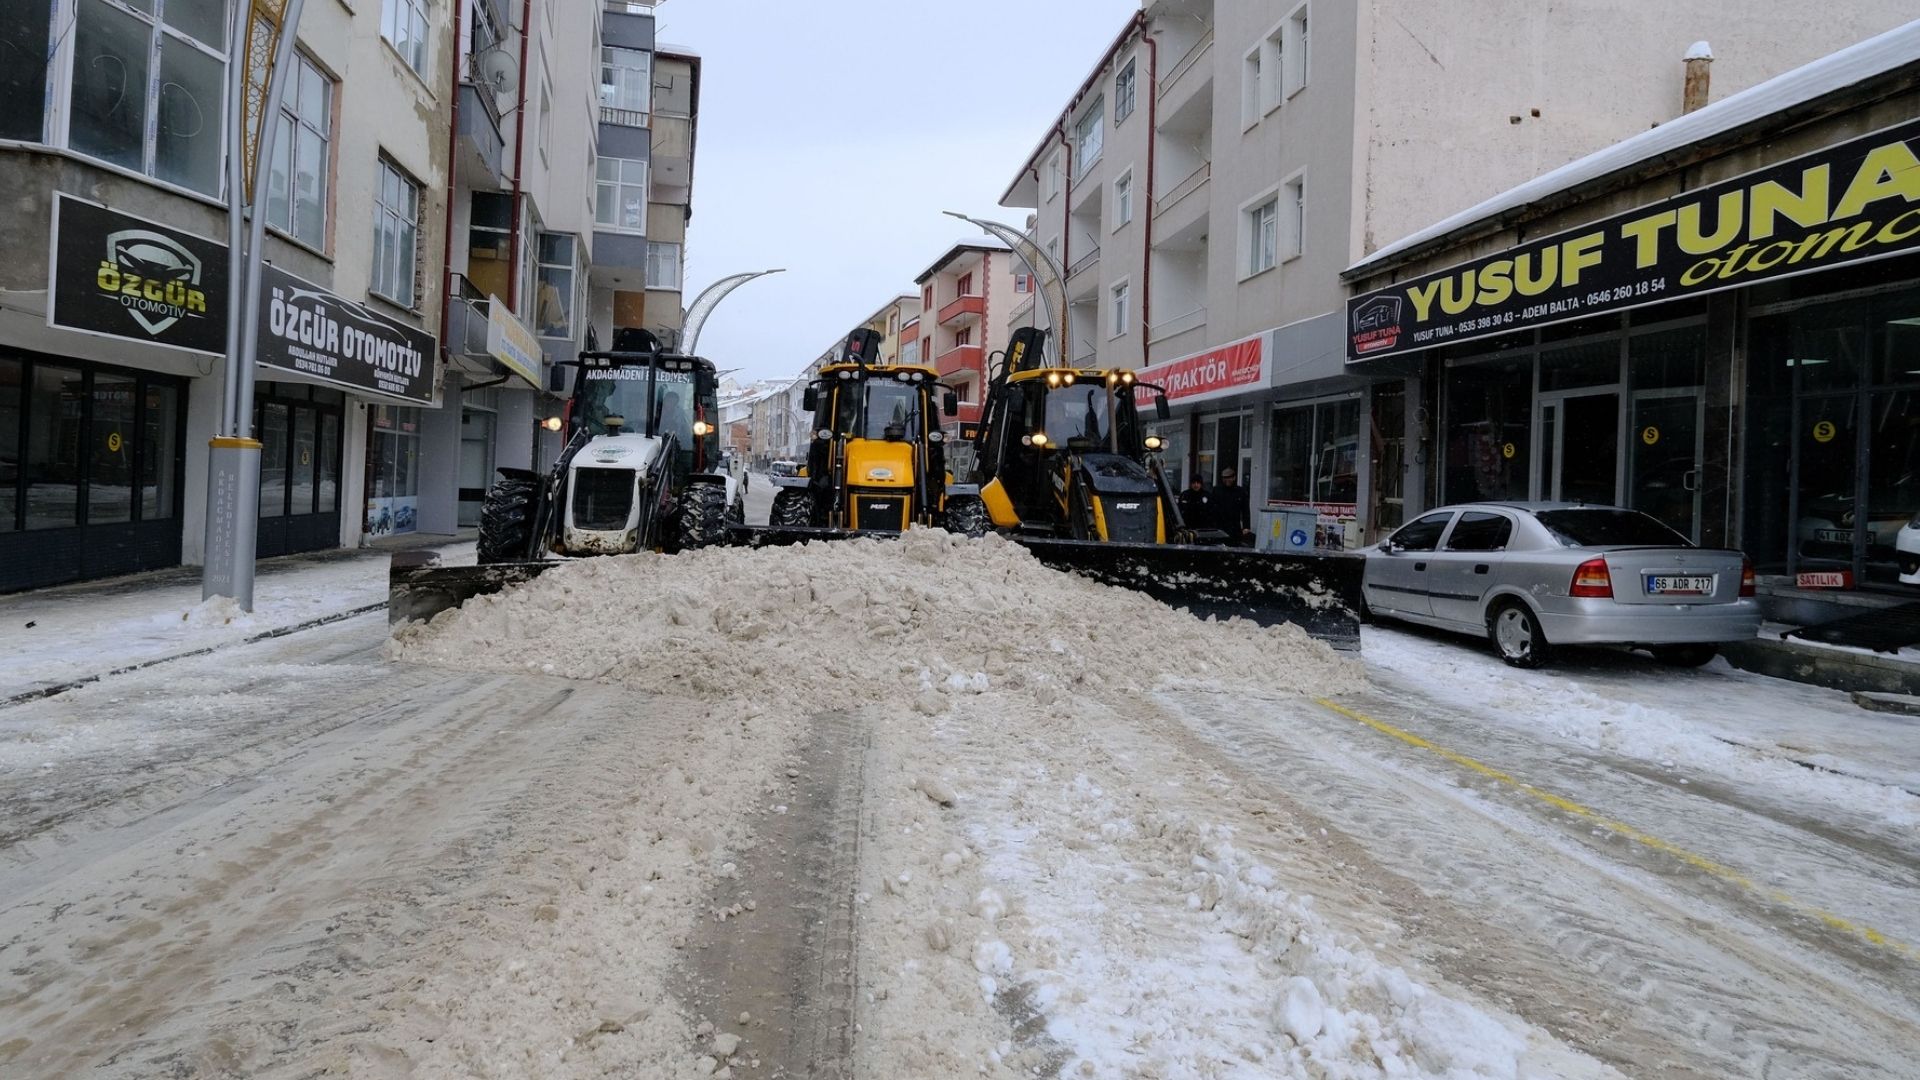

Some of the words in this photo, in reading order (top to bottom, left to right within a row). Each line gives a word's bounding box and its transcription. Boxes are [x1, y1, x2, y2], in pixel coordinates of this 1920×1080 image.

[1405, 230, 1605, 322] YUSUF
[1621, 140, 1920, 270] TUNA
[97, 260, 206, 313] ÖZGÜR
[120, 294, 186, 318] OTOMOTİV
[1413, 330, 1435, 343] YUSUF
[1435, 326, 1454, 338] TUNA
[1458, 320, 1476, 333] 0535
[1477, 317, 1491, 330] 398
[1492, 314, 1502, 326] 30
[1503, 312, 1513, 324] 43
[1521, 305, 1548, 320] ADEM
[1549, 299, 1580, 314] BALTA
[1587, 292, 1611, 306] 0546
[1613, 287, 1632, 301] 260
[1635, 282, 1649, 296] 18
[1651, 277, 1666, 292] 54
[270, 286, 339, 354] ÖZGÜR
[343, 325, 422, 378] OTOMOTİV
[1353, 330, 1378, 344] YUSUF
[1379, 325, 1401, 338] TUNA
[586, 367, 644, 380] AKDAĞMADENİ
[1166, 358, 1228, 393] TRAKTÖR
[1116, 502, 1140, 510] MST
[1655, 578, 1667, 590] 66
[1672, 578, 1690, 590] ADR
[1694, 578, 1711, 590] 217
[1799, 574, 1838, 586] SATILIK
